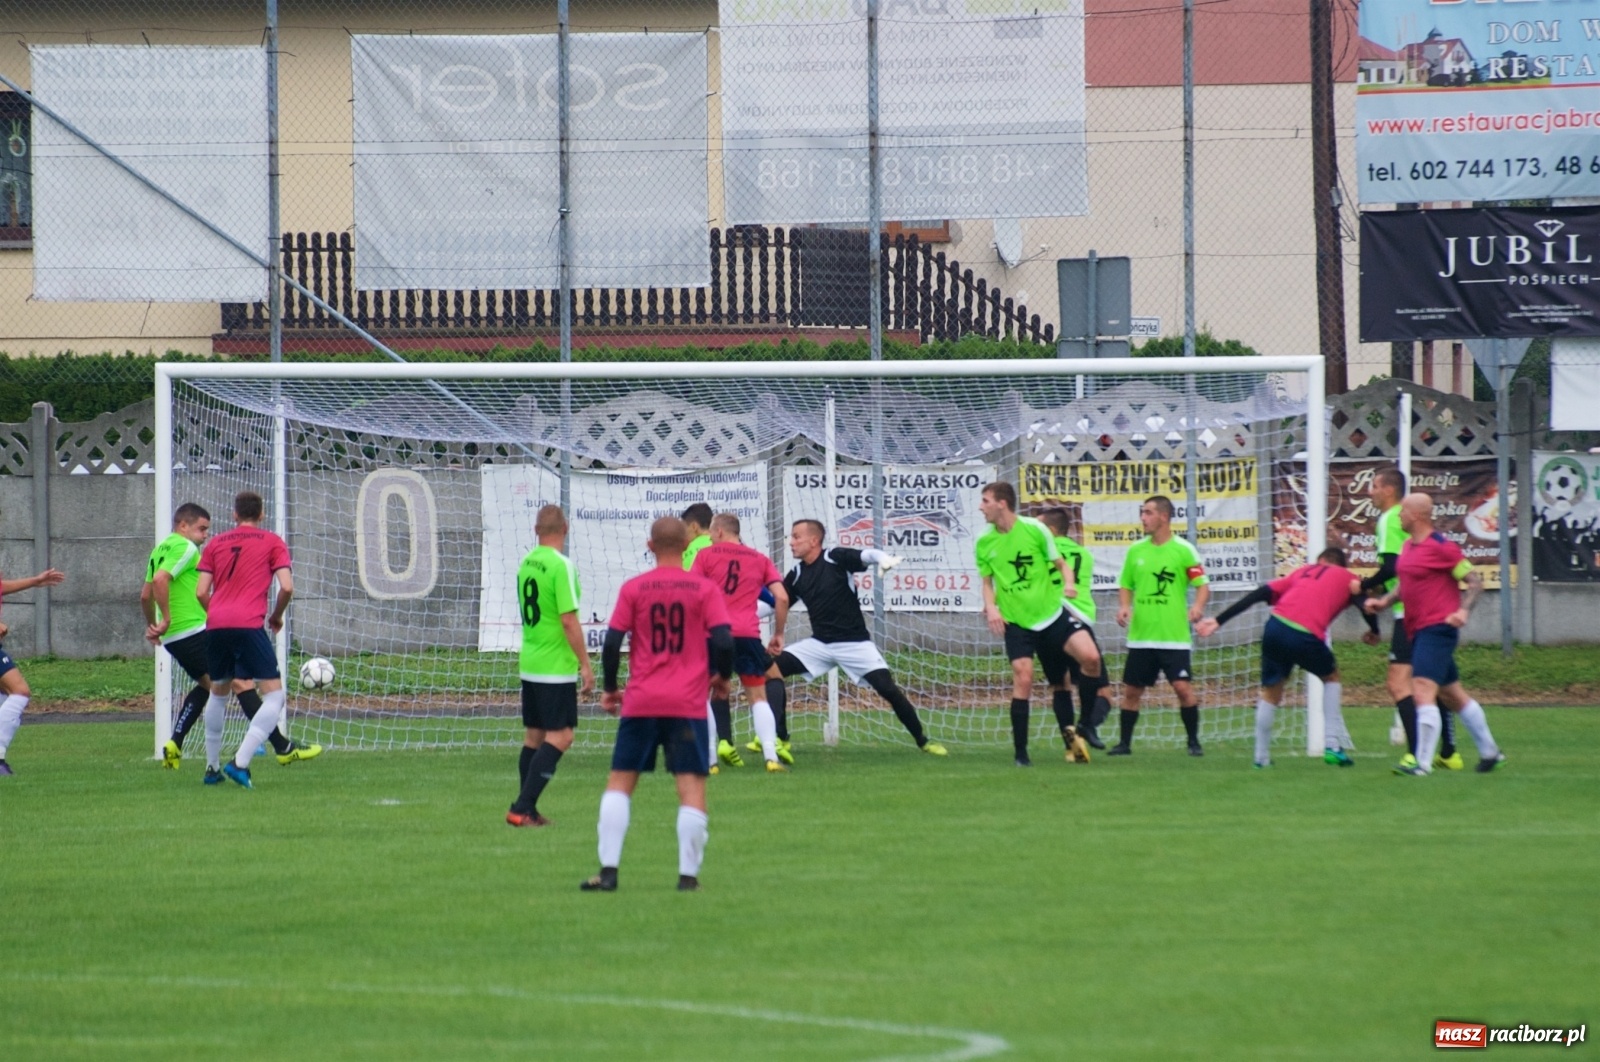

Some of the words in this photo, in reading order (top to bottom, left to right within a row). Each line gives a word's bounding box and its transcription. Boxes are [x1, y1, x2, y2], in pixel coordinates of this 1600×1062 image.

[1488, 19, 1561, 44] DOM
[1368, 162, 1402, 182] tel.
[1409, 160, 1448, 181] 602
[1455, 159, 1495, 179] 744
[1504, 157, 1548, 178] 173,
[1555, 155, 1582, 176] 48
[1508, 273, 1590, 286] POŚPIECH
[645, 489, 705, 503] Docieplenia
[707, 487, 759, 502] budynków
[576, 507, 649, 523] Kompleksowe
[230, 546, 242, 581] 7
[723, 559, 741, 595] 6
[893, 574, 928, 591] 196
[934, 574, 971, 591] 012
[523, 576, 541, 629] 8
[912, 595, 950, 606] Nowa
[954, 595, 963, 606] 8
[651, 602, 685, 655] 69
